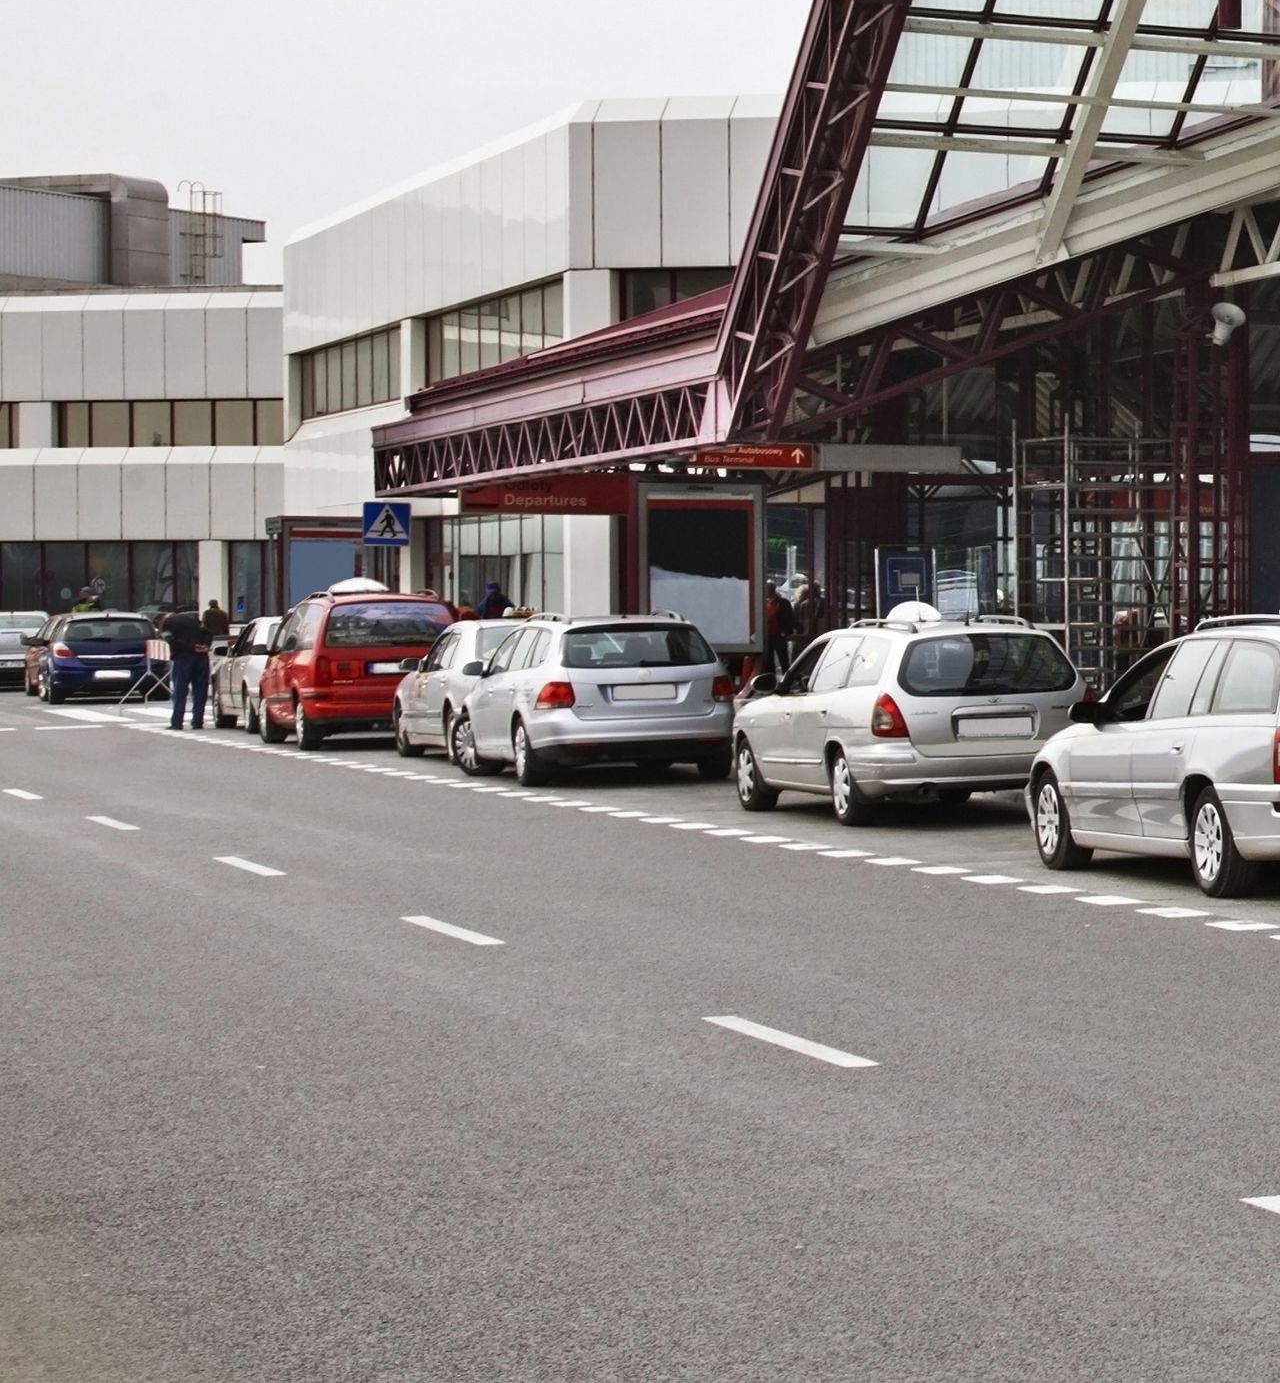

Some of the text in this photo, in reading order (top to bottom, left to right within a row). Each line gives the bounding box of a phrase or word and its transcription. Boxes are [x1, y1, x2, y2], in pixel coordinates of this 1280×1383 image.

[704, 455, 755, 464] Bus Terminal
[504, 493, 588, 508] Departures
